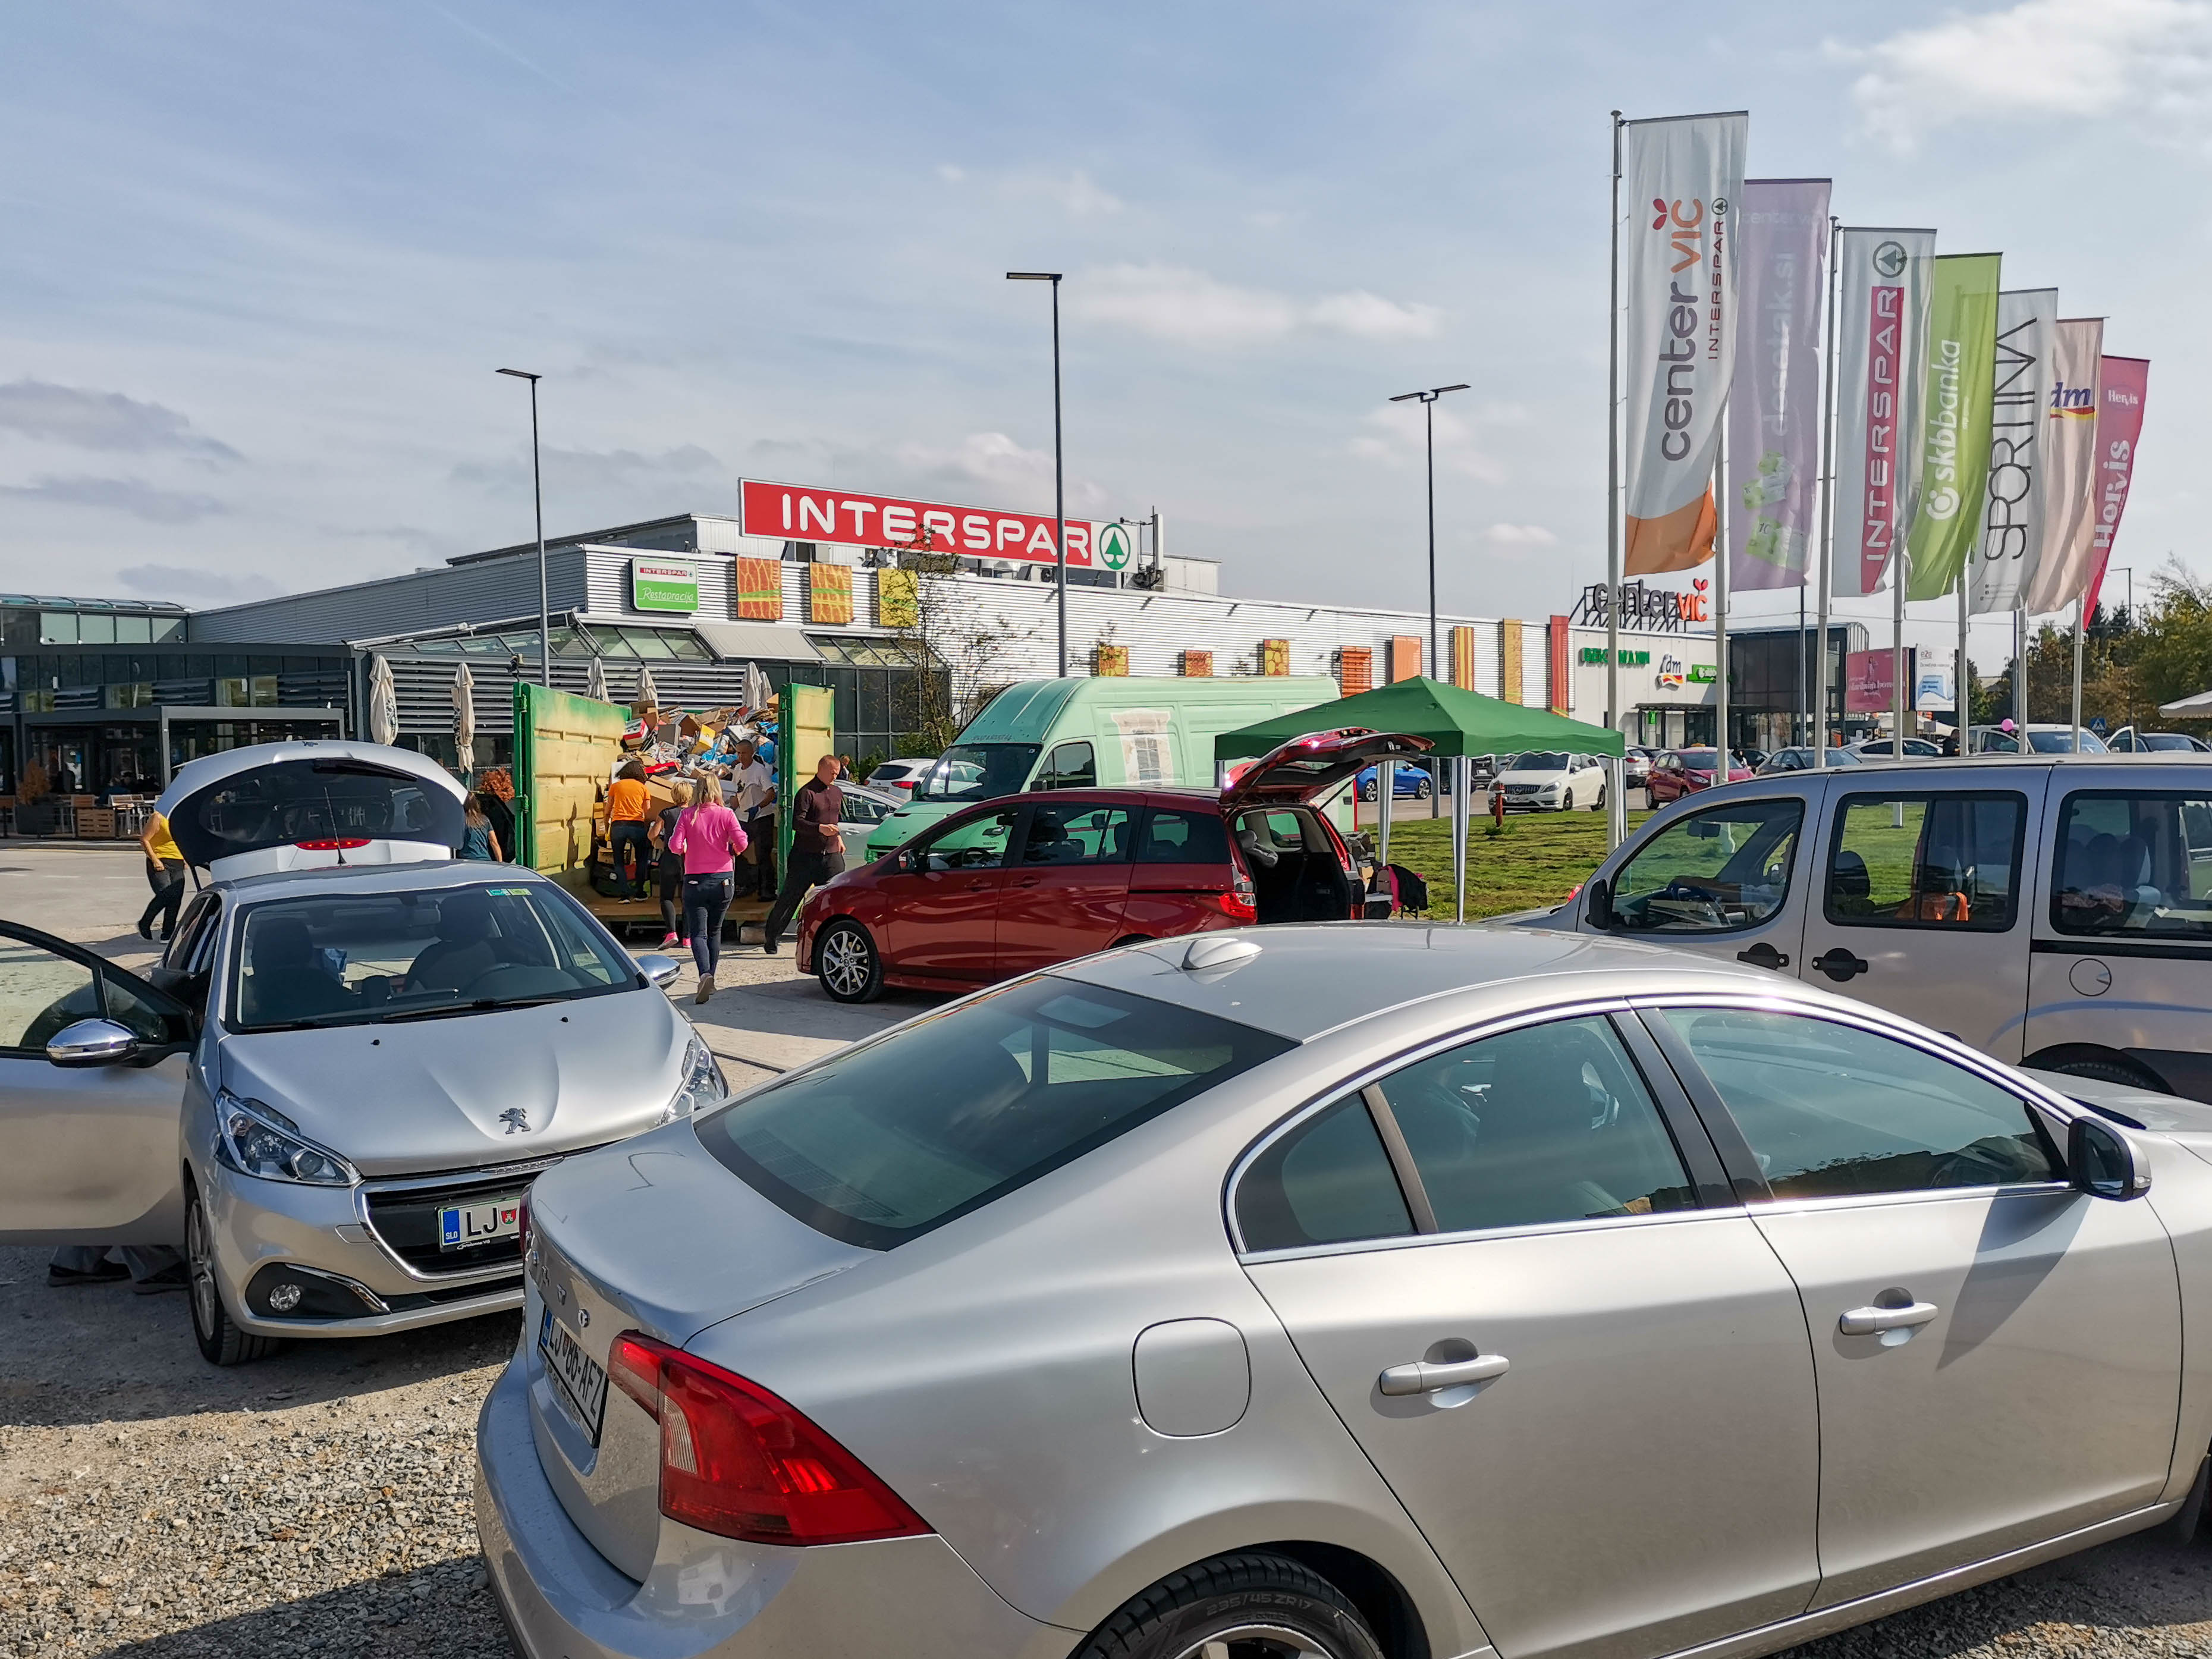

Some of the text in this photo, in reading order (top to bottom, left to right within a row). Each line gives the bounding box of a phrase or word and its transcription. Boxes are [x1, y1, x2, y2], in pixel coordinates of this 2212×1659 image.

[1707, 220, 1724, 361] INTERSPAR
[2050, 381, 2092, 409] dm
[2108, 389, 2139, 406] Hervis
[1866, 288, 1899, 561] INTERSPAR
[2092, 439, 2131, 548] Hervis
[781, 492, 1089, 560] INTERSPAR
[643, 567, 687, 576] INTERSPAR
[642, 586, 694, 604] Restavracija
[1666, 655, 1682, 674] dm
[445, 1230, 458, 1240] SLO
[466, 1206, 498, 1237] LJ
